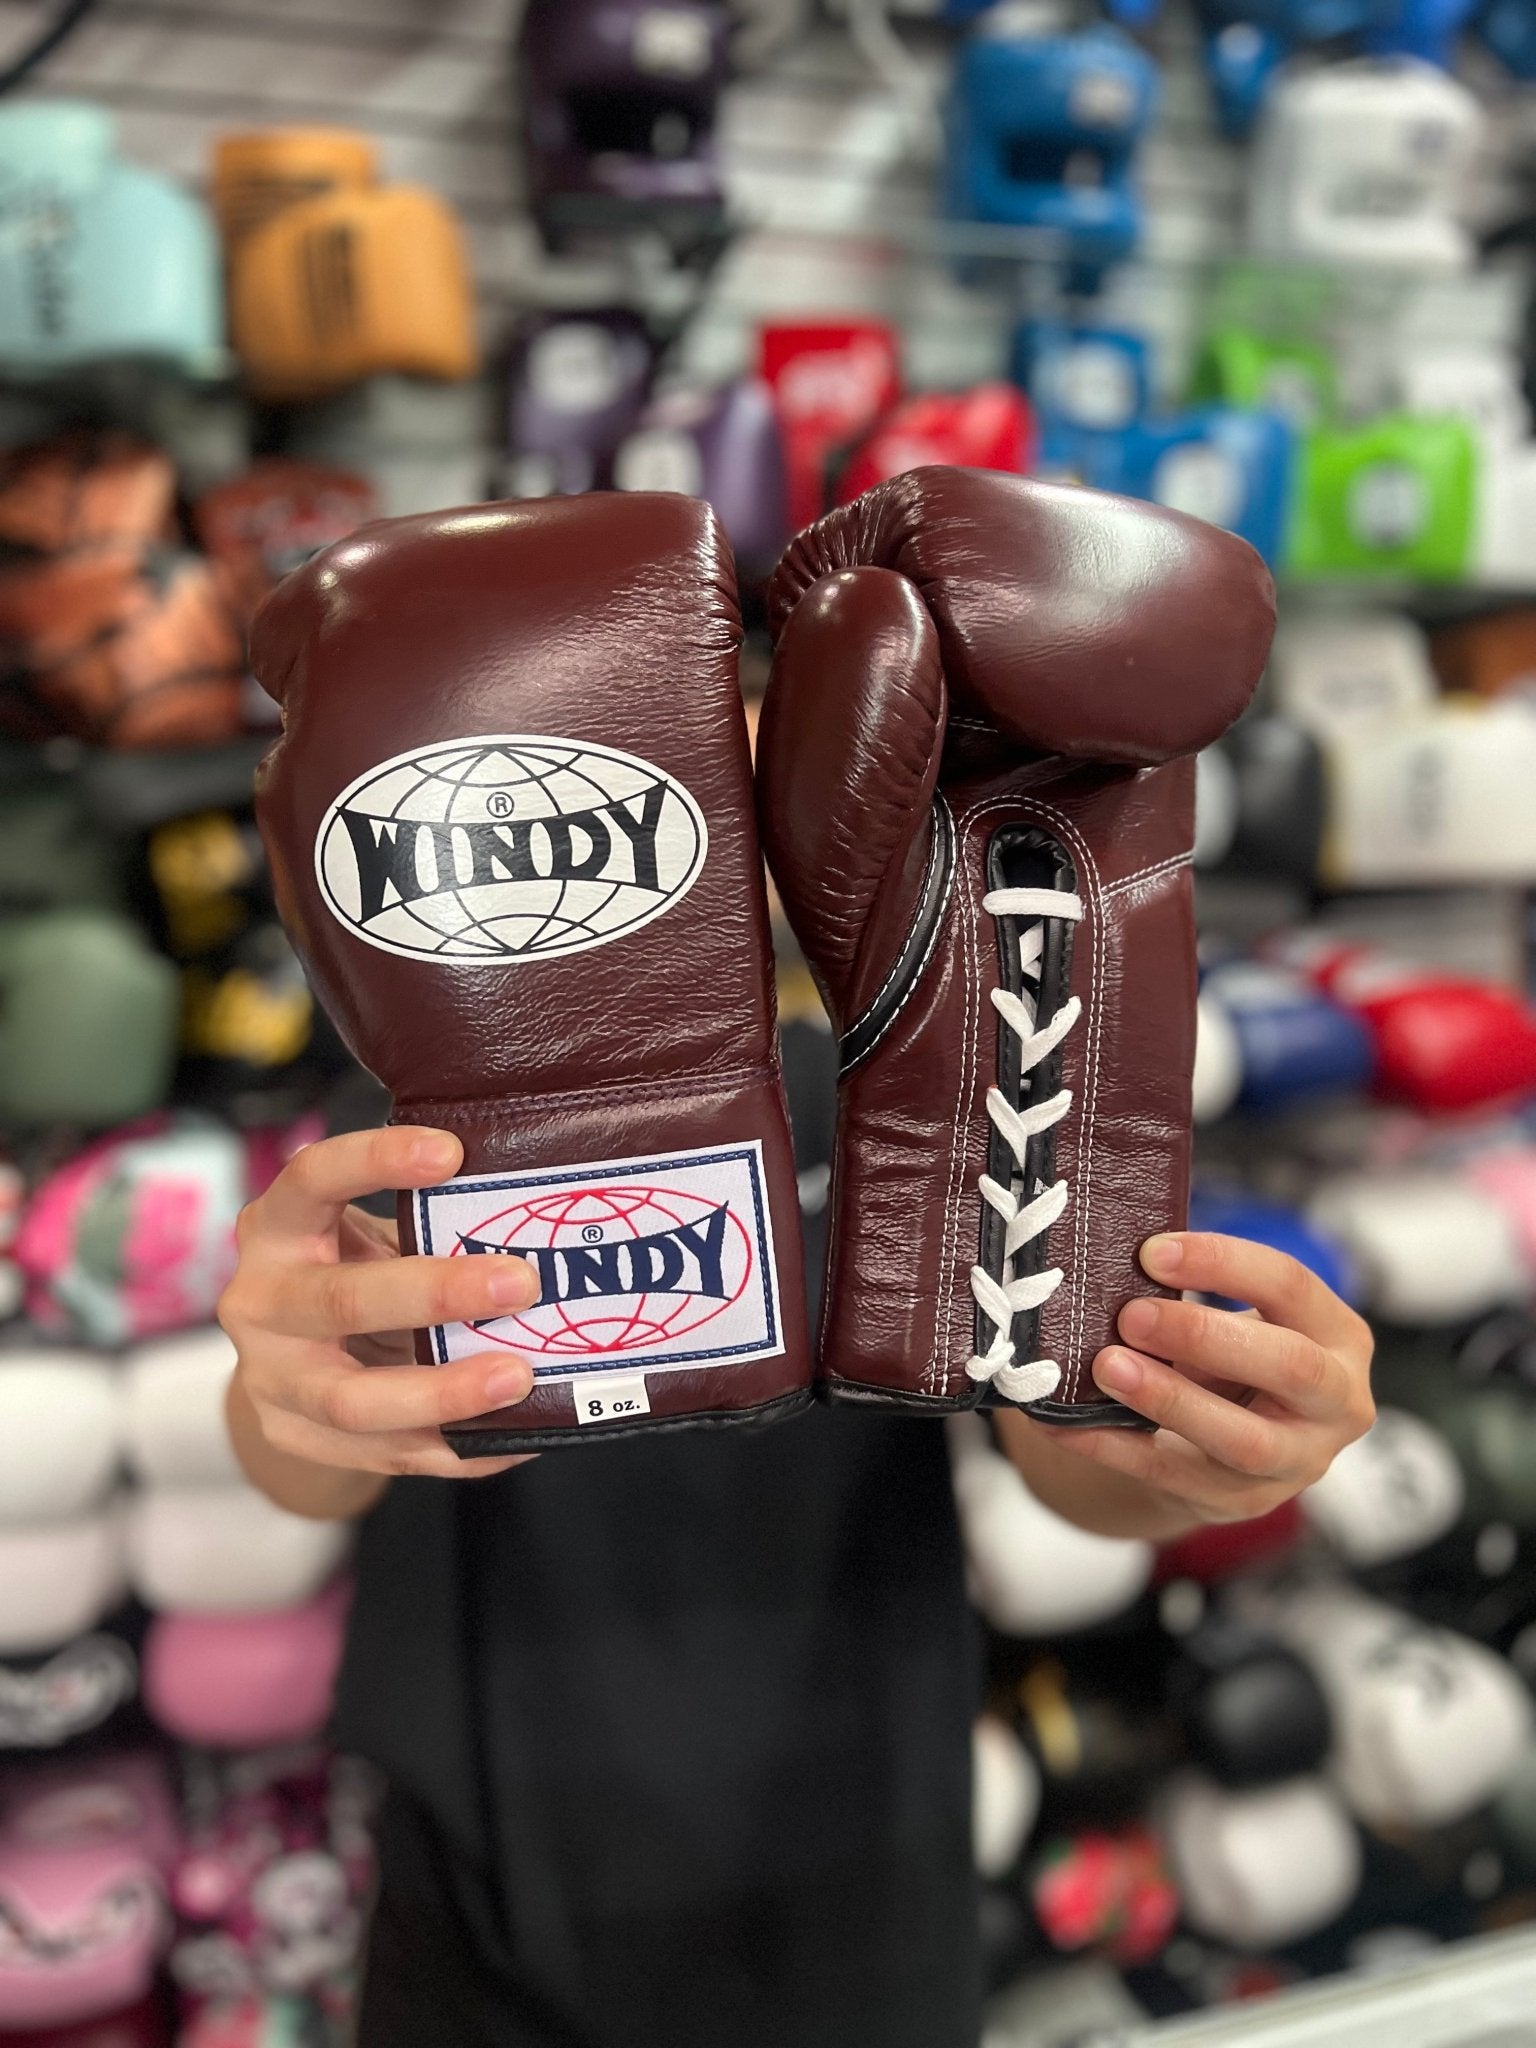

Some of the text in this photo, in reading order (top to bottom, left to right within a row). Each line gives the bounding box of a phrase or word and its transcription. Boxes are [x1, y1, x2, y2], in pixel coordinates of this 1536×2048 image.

[336, 780, 672, 924] WINDY
[588, 1400, 641, 1416] 8 oz.
